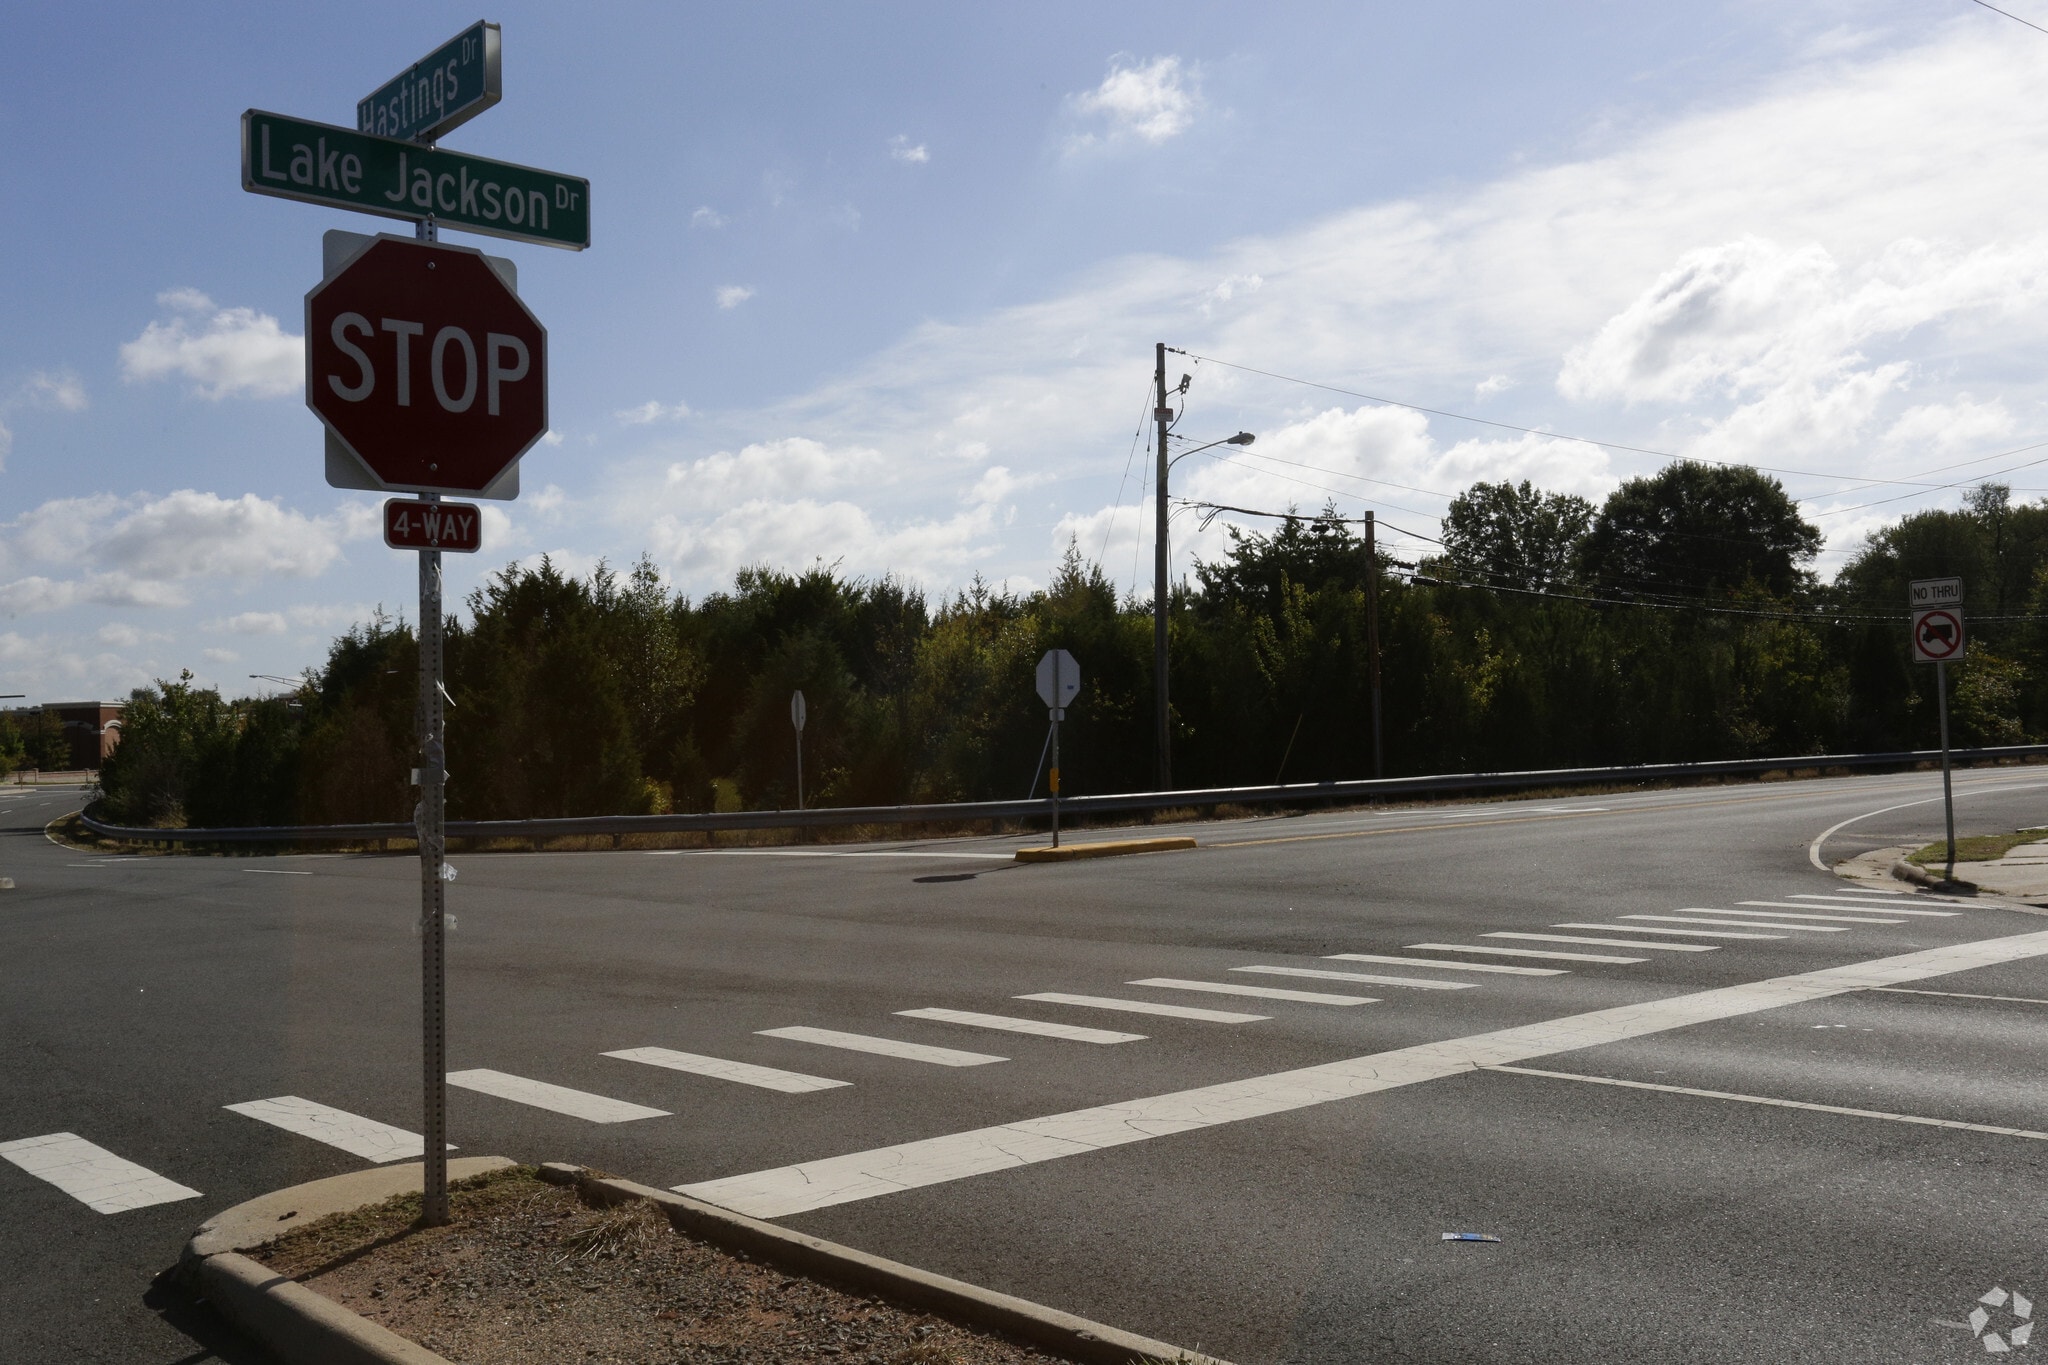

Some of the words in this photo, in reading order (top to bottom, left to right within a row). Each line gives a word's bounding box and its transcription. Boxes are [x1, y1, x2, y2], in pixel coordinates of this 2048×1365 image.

[363, 58, 459, 137] Hastings
[462, 37, 477, 66] Dr
[261, 123, 363, 194] Lake
[384, 152, 549, 231] Jackson
[555, 183, 579, 212] Dr
[327, 311, 531, 417] STOP
[393, 510, 473, 542] 4-WAY
[1913, 587, 1928, 600] NO
[1931, 584, 1958, 599] THRU
